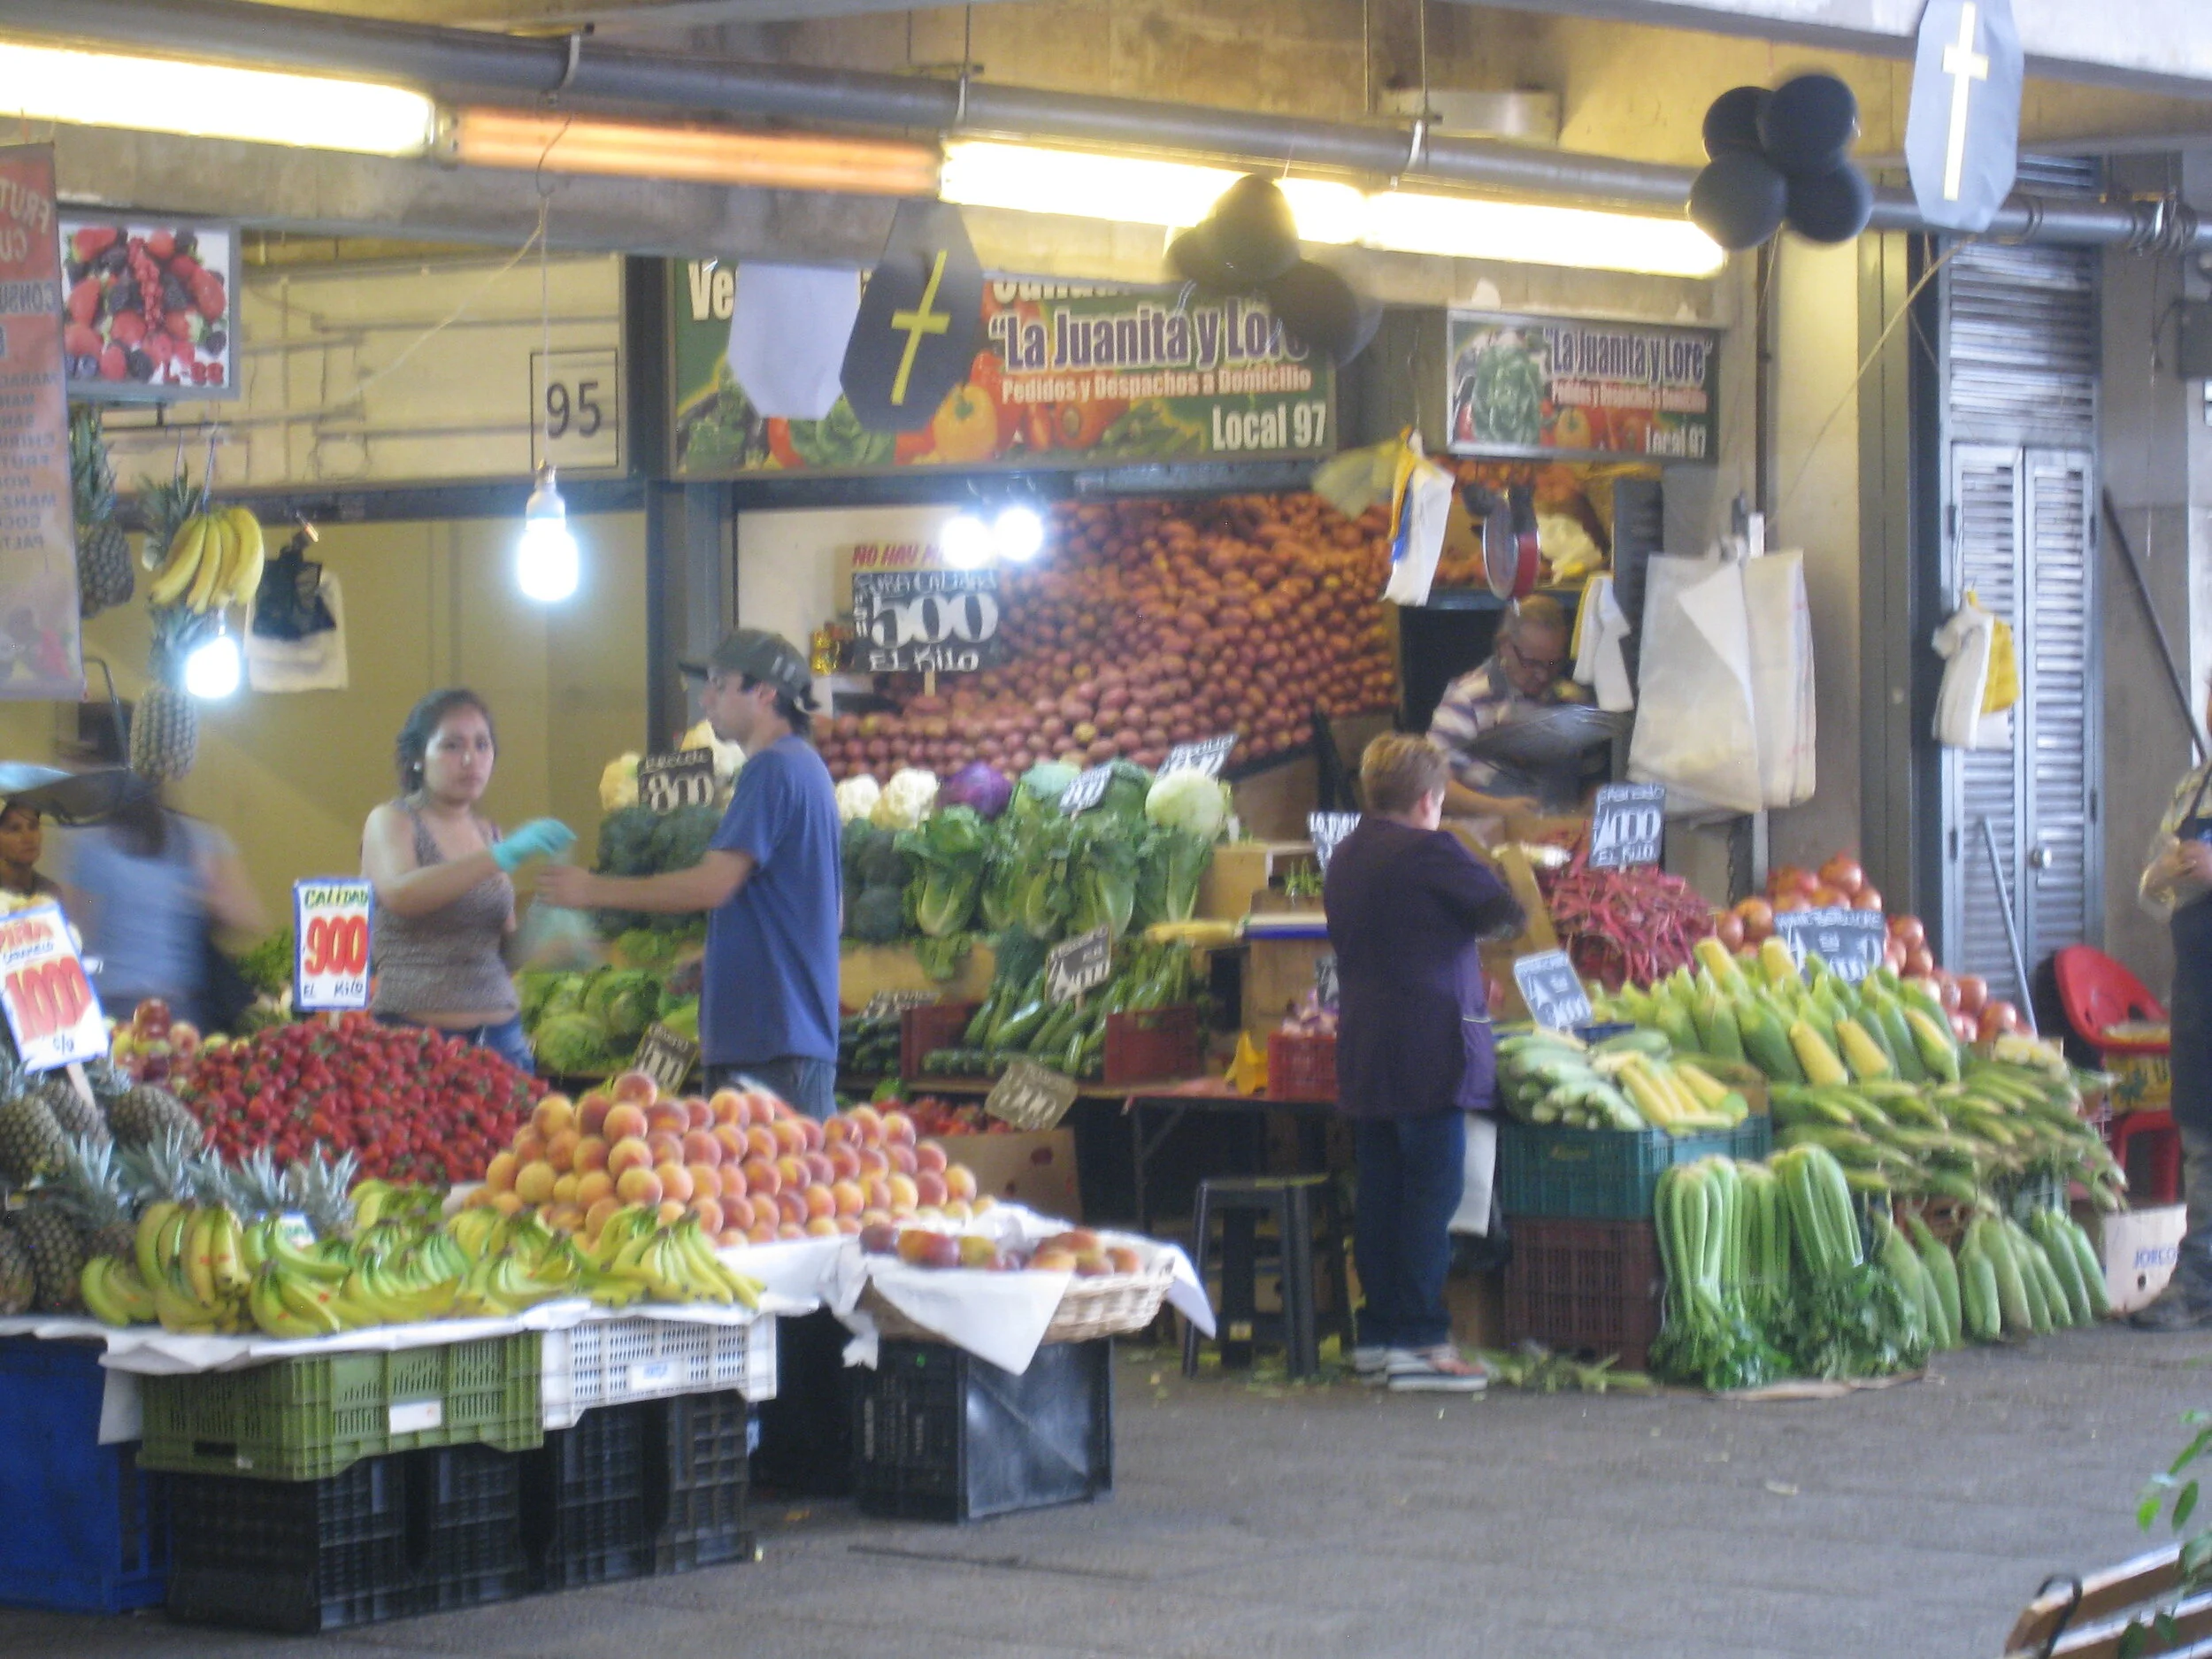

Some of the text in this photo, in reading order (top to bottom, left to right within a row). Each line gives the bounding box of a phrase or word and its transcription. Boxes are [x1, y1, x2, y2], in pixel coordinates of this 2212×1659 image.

[1052, 300, 1191, 372] Juanita
[1194, 306, 1221, 372] y
[546, 381, 601, 439] 95
[1002, 364, 1312, 403] Pedidos y Despachos a Domicilio
[1212, 401, 1327, 451] Local 97
[872, 591, 999, 649] 500
[304, 914, 369, 977] 900
[5, 955, 94, 1045] 1000
